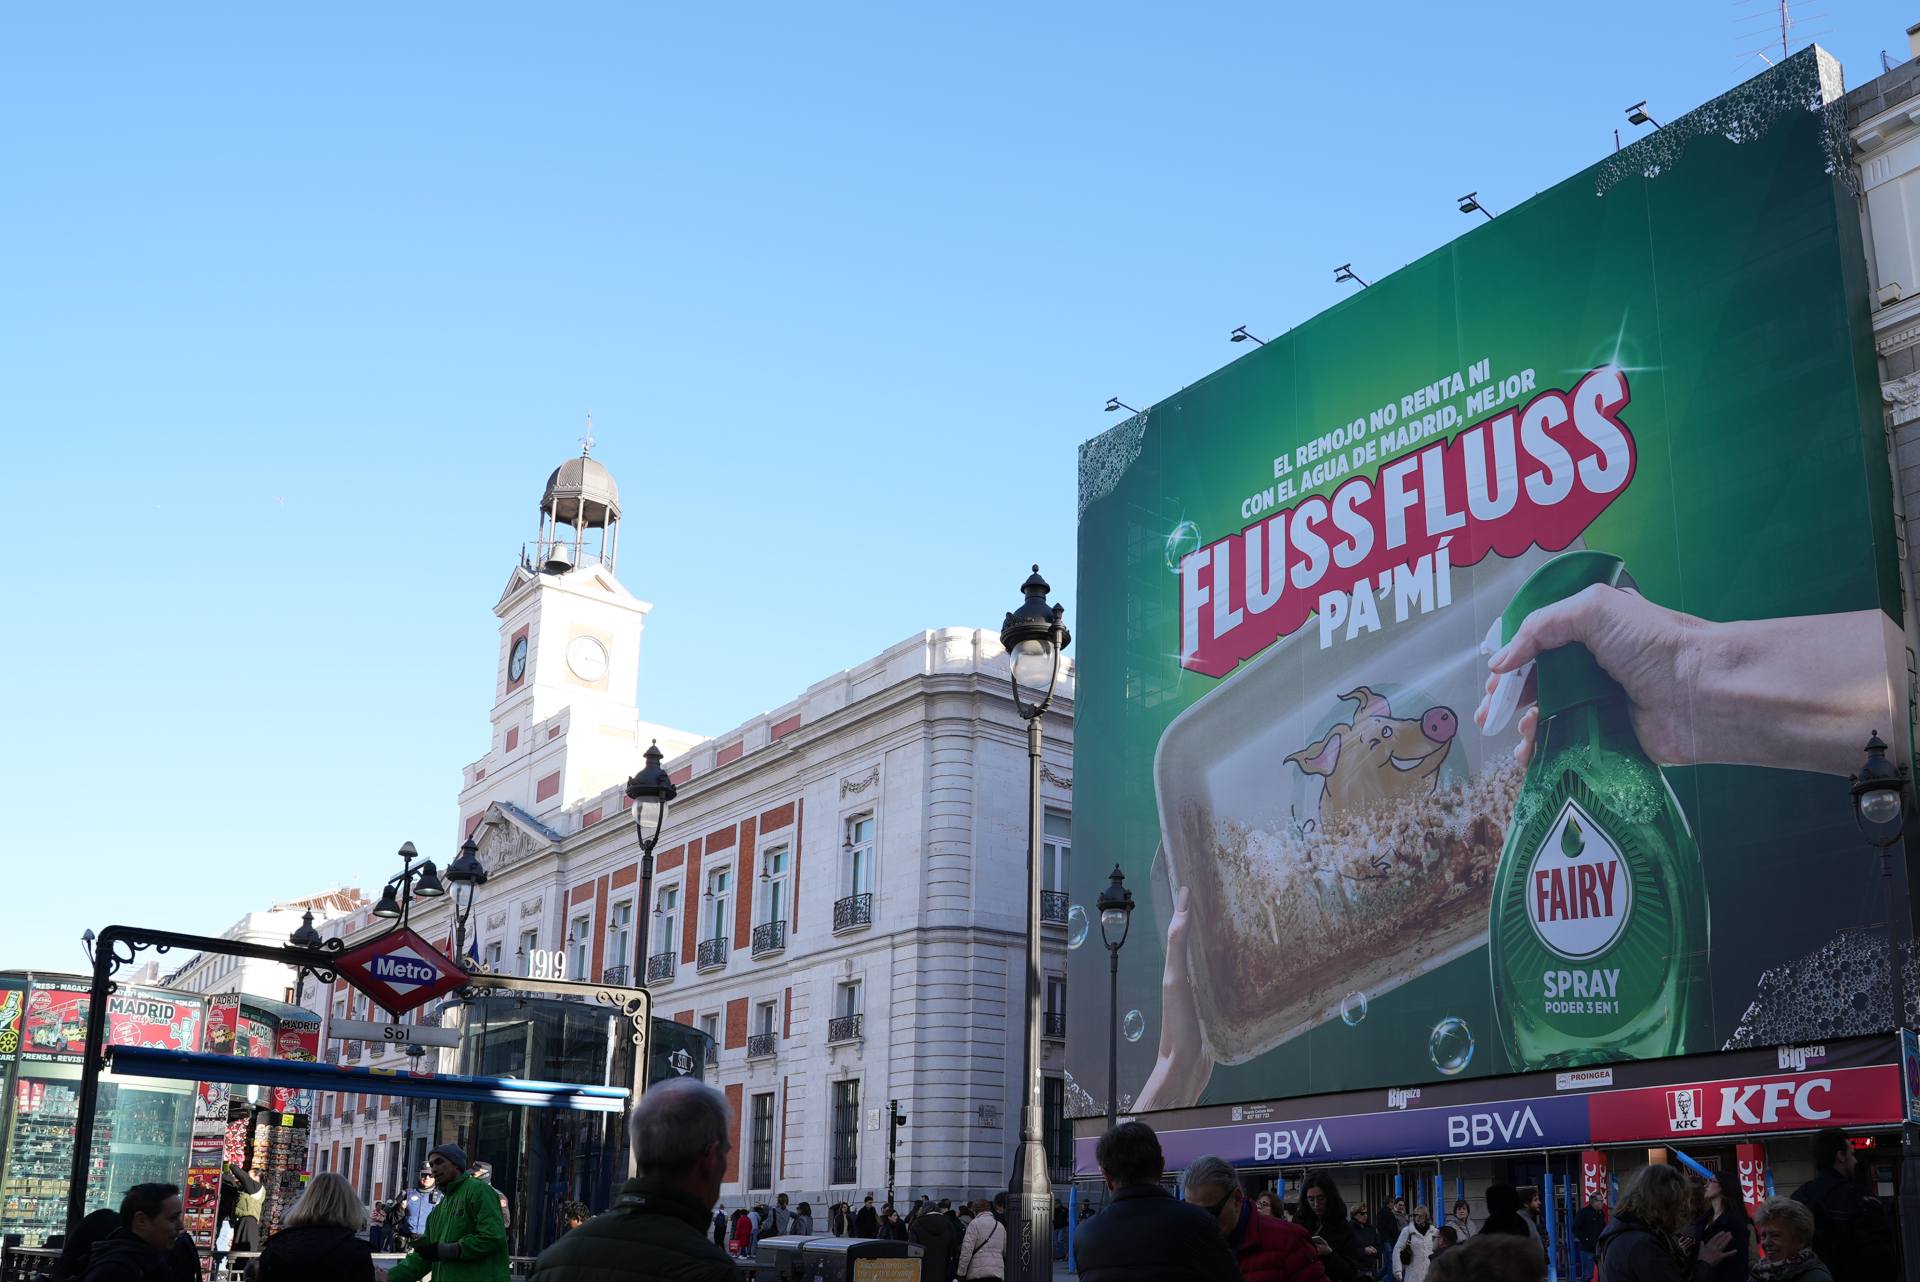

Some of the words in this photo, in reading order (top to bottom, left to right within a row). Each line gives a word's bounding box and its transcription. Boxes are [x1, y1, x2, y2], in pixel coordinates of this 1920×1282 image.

[1274, 454, 1292, 479] EL
[1296, 418, 1366, 468] REMOJO
[1370, 403, 1397, 433] NO
[1401, 372, 1465, 419] RENTA
[1469, 357, 1491, 387] NI
[1242, 487, 1274, 519] CON
[1278, 479, 1297, 503] EL
[1301, 454, 1349, 493] AGUA
[1353, 440, 1376, 469] DE
[1381, 405, 1463, 457] MADRID,
[1466, 368, 1536, 418] MEJOR
[1182, 480, 1374, 657] FLUSS
[1383, 366, 1631, 550] FLUSS
[1535, 860, 1617, 923] FAIRY
[376, 958, 433, 981] Metro
[528, 949, 567, 979] 1919
[1543, 968, 1620, 998] SPRAY
[108, 998, 175, 1020] MADRID
[1545, 1002, 1584, 1014] PODER
[1586, 1001, 1594, 1014] 3
[1596, 1002, 1611, 1014] EN
[1613, 1001, 1619, 1014] 1
[283, 1020, 320, 1030] MADRID
[383, 1027, 410, 1040] Sol
[22, 1052, 52, 1061] PRENSA
[1571, 1071, 1610, 1081] PROINGEA
[1716, 1078, 1832, 1127] KFC
[1448, 1105, 1544, 1148] BBVA
[1675, 1119, 1697, 1129] KFC
[1254, 1124, 1331, 1161] BBVA
[1584, 1163, 1597, 1203] KFC
[1739, 1160, 1755, 1205] KFC
[1755, 1160, 1765, 1202] KFC
